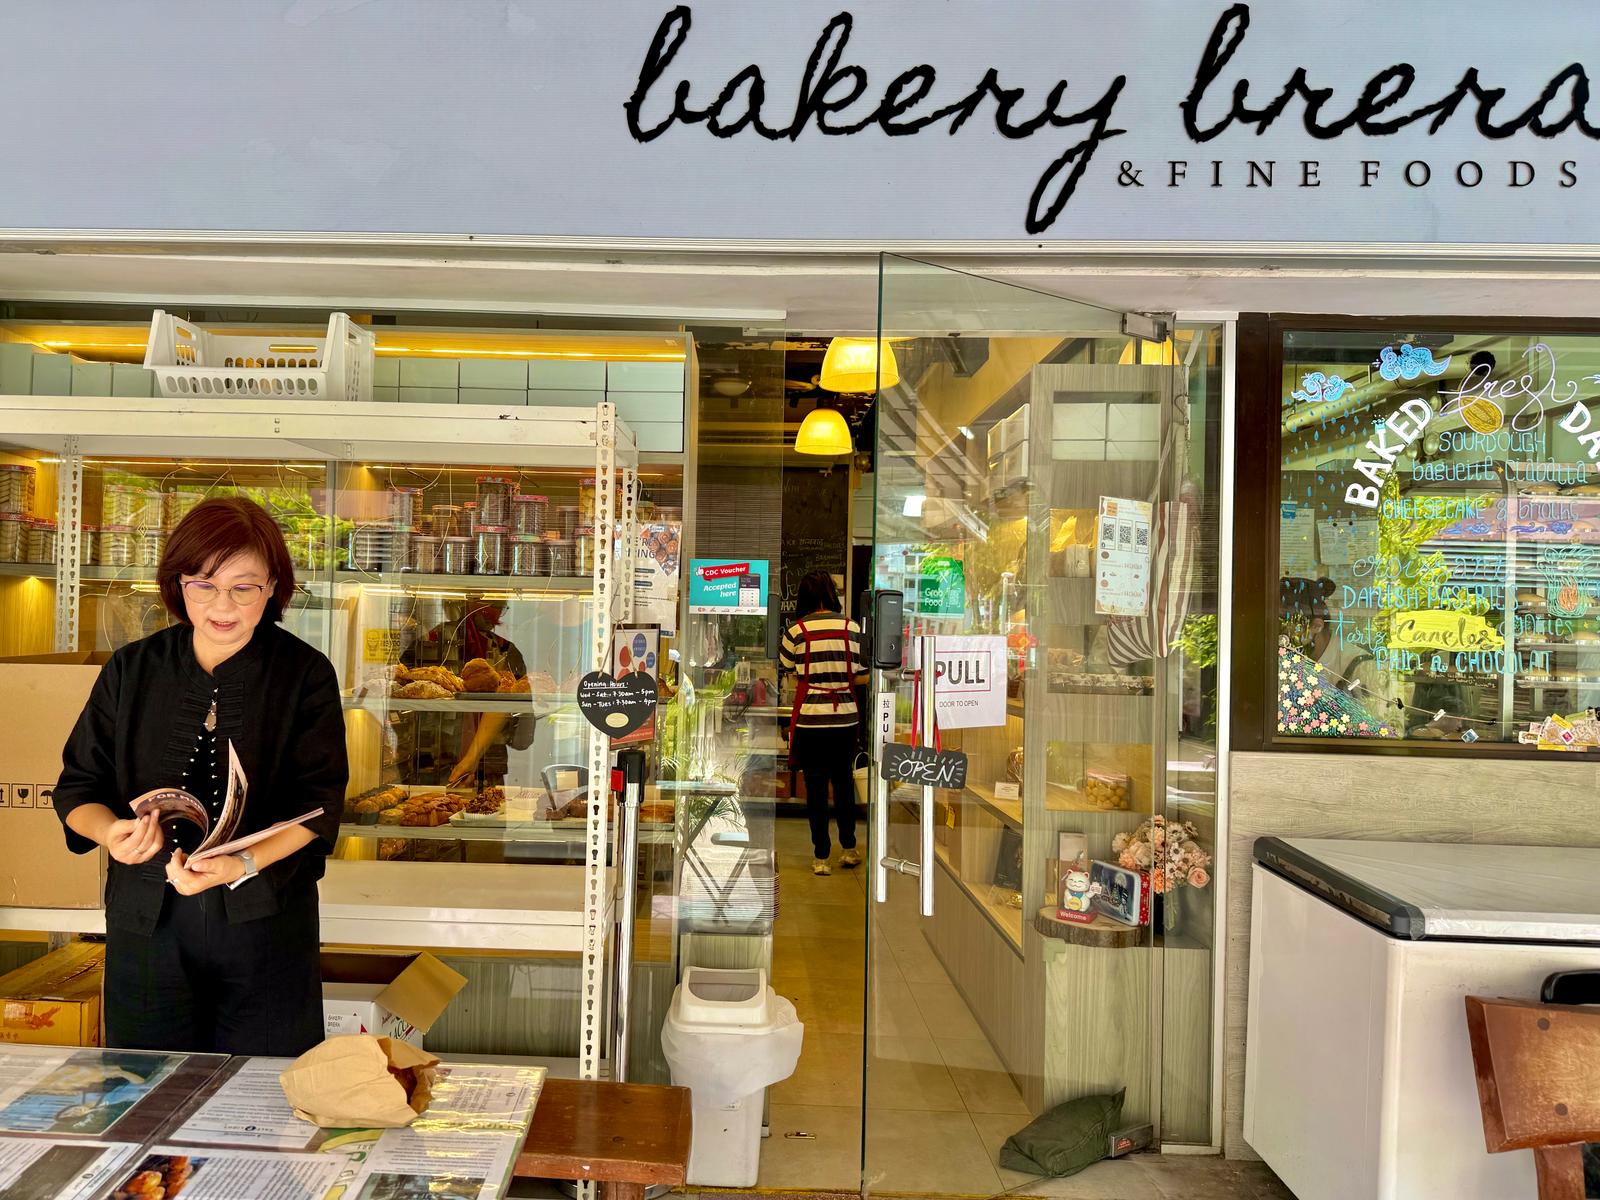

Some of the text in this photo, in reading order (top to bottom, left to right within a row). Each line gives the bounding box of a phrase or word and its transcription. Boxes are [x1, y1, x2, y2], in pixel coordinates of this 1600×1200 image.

[623, 3, 1600, 234] bakery brera
[1119, 160, 1578, 188] & FINE FOODS
[1438, 431, 1546, 454] SOURDOUGH
[1344, 398, 1434, 509] BAKED
[635, 548, 655, 559] ING
[704, 566, 747, 577] CDC Voucher
[703, 582, 737, 592] Accepted
[924, 587, 944, 598] Grab
[719, 590, 737, 598] here
[924, 597, 944, 607] Food
[1455, 650, 1552, 674] CHOCOLAT
[935, 660, 985, 685] PULL
[583, 680, 607, 689] Opening
[641, 688, 655, 697] 5pm
[643, 698, 657, 706] 4pm
[939, 700, 955, 708] DOOR
[898, 759, 955, 782] OPEN
[1059, 911, 1087, 921] Welcome
